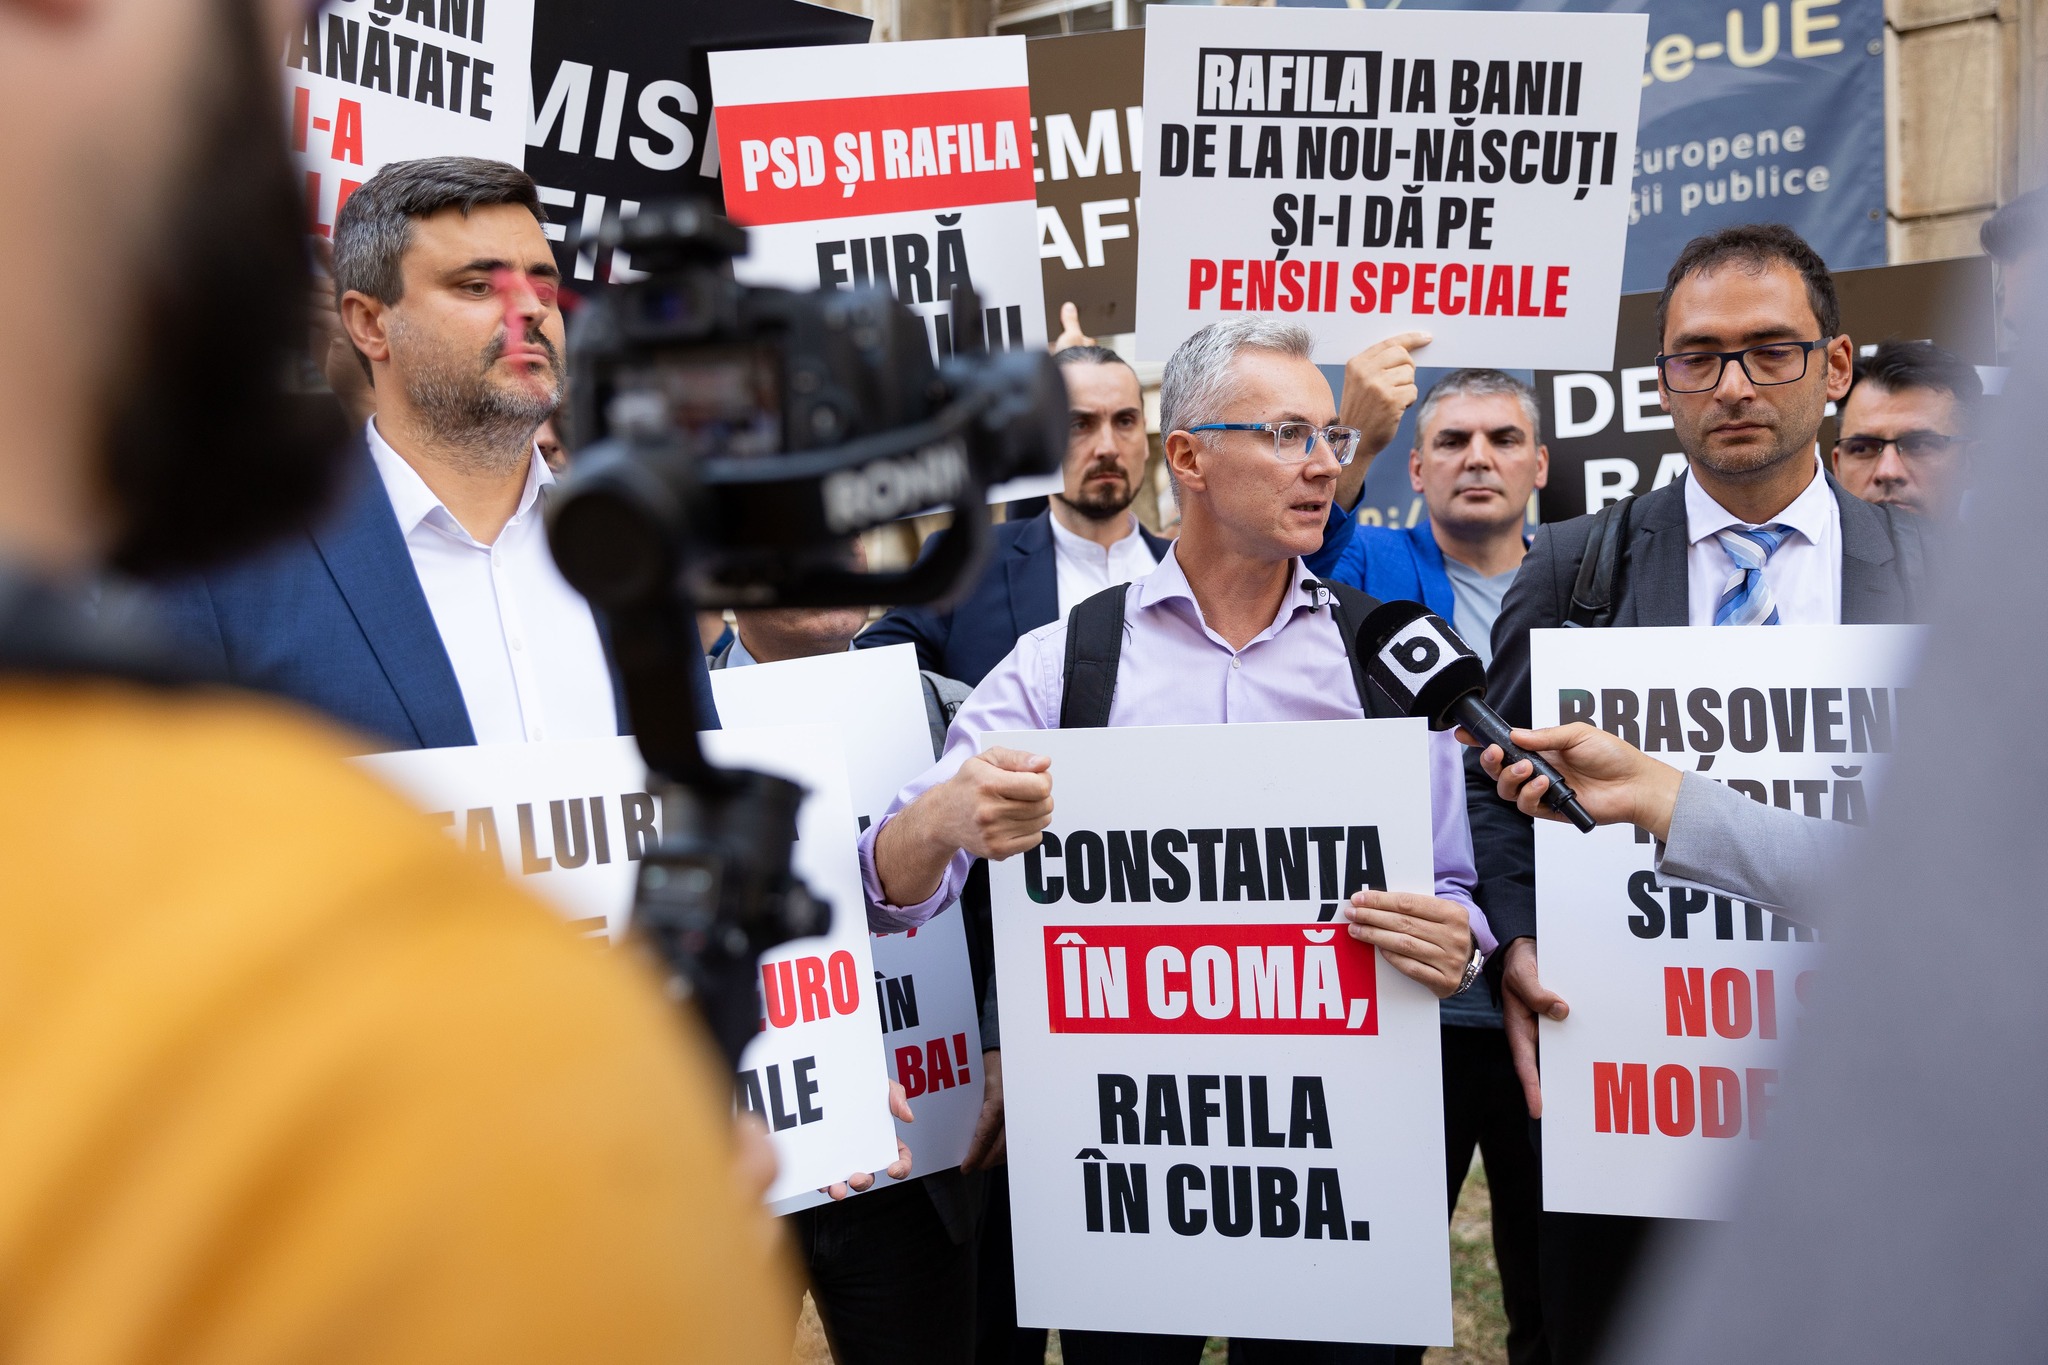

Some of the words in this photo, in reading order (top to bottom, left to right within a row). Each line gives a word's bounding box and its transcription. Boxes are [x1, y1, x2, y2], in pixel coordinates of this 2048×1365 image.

[1641, 0, 1845, 88] e-UE
[1204, 53, 1368, 113] RAFILA
[1389, 58, 1436, 114] IA
[1448, 60, 1583, 117] BANII
[740, 135, 825, 192] PSD
[834, 131, 875, 198] ȘI
[882, 120, 1021, 180] RAFILA
[1159, 123, 1215, 178] DE
[1228, 124, 1286, 179] LA
[1296, 116, 1618, 200] NOU-NĂSCUȚI
[1680, 165, 1831, 216] publice
[1271, 193, 1350, 261] ȘI-I
[1362, 184, 1424, 249] DĂ
[1436, 197, 1496, 250] PE
[1188, 259, 1339, 313] PENSII
[1350, 263, 1571, 318] SPECIALE
[516, 795, 612, 876] LUI
[1024, 825, 1388, 922] CONSTANȚA
[757, 950, 860, 1032] URO
[1053, 932, 1130, 1019] ÎN
[1145, 929, 1370, 1029] COMĂ,
[1664, 966, 1778, 1040] NOI
[1097, 1073, 1333, 1149] RAFILA
[1074, 1148, 1150, 1234] ÎN
[1165, 1162, 1371, 1241] CUBA.
